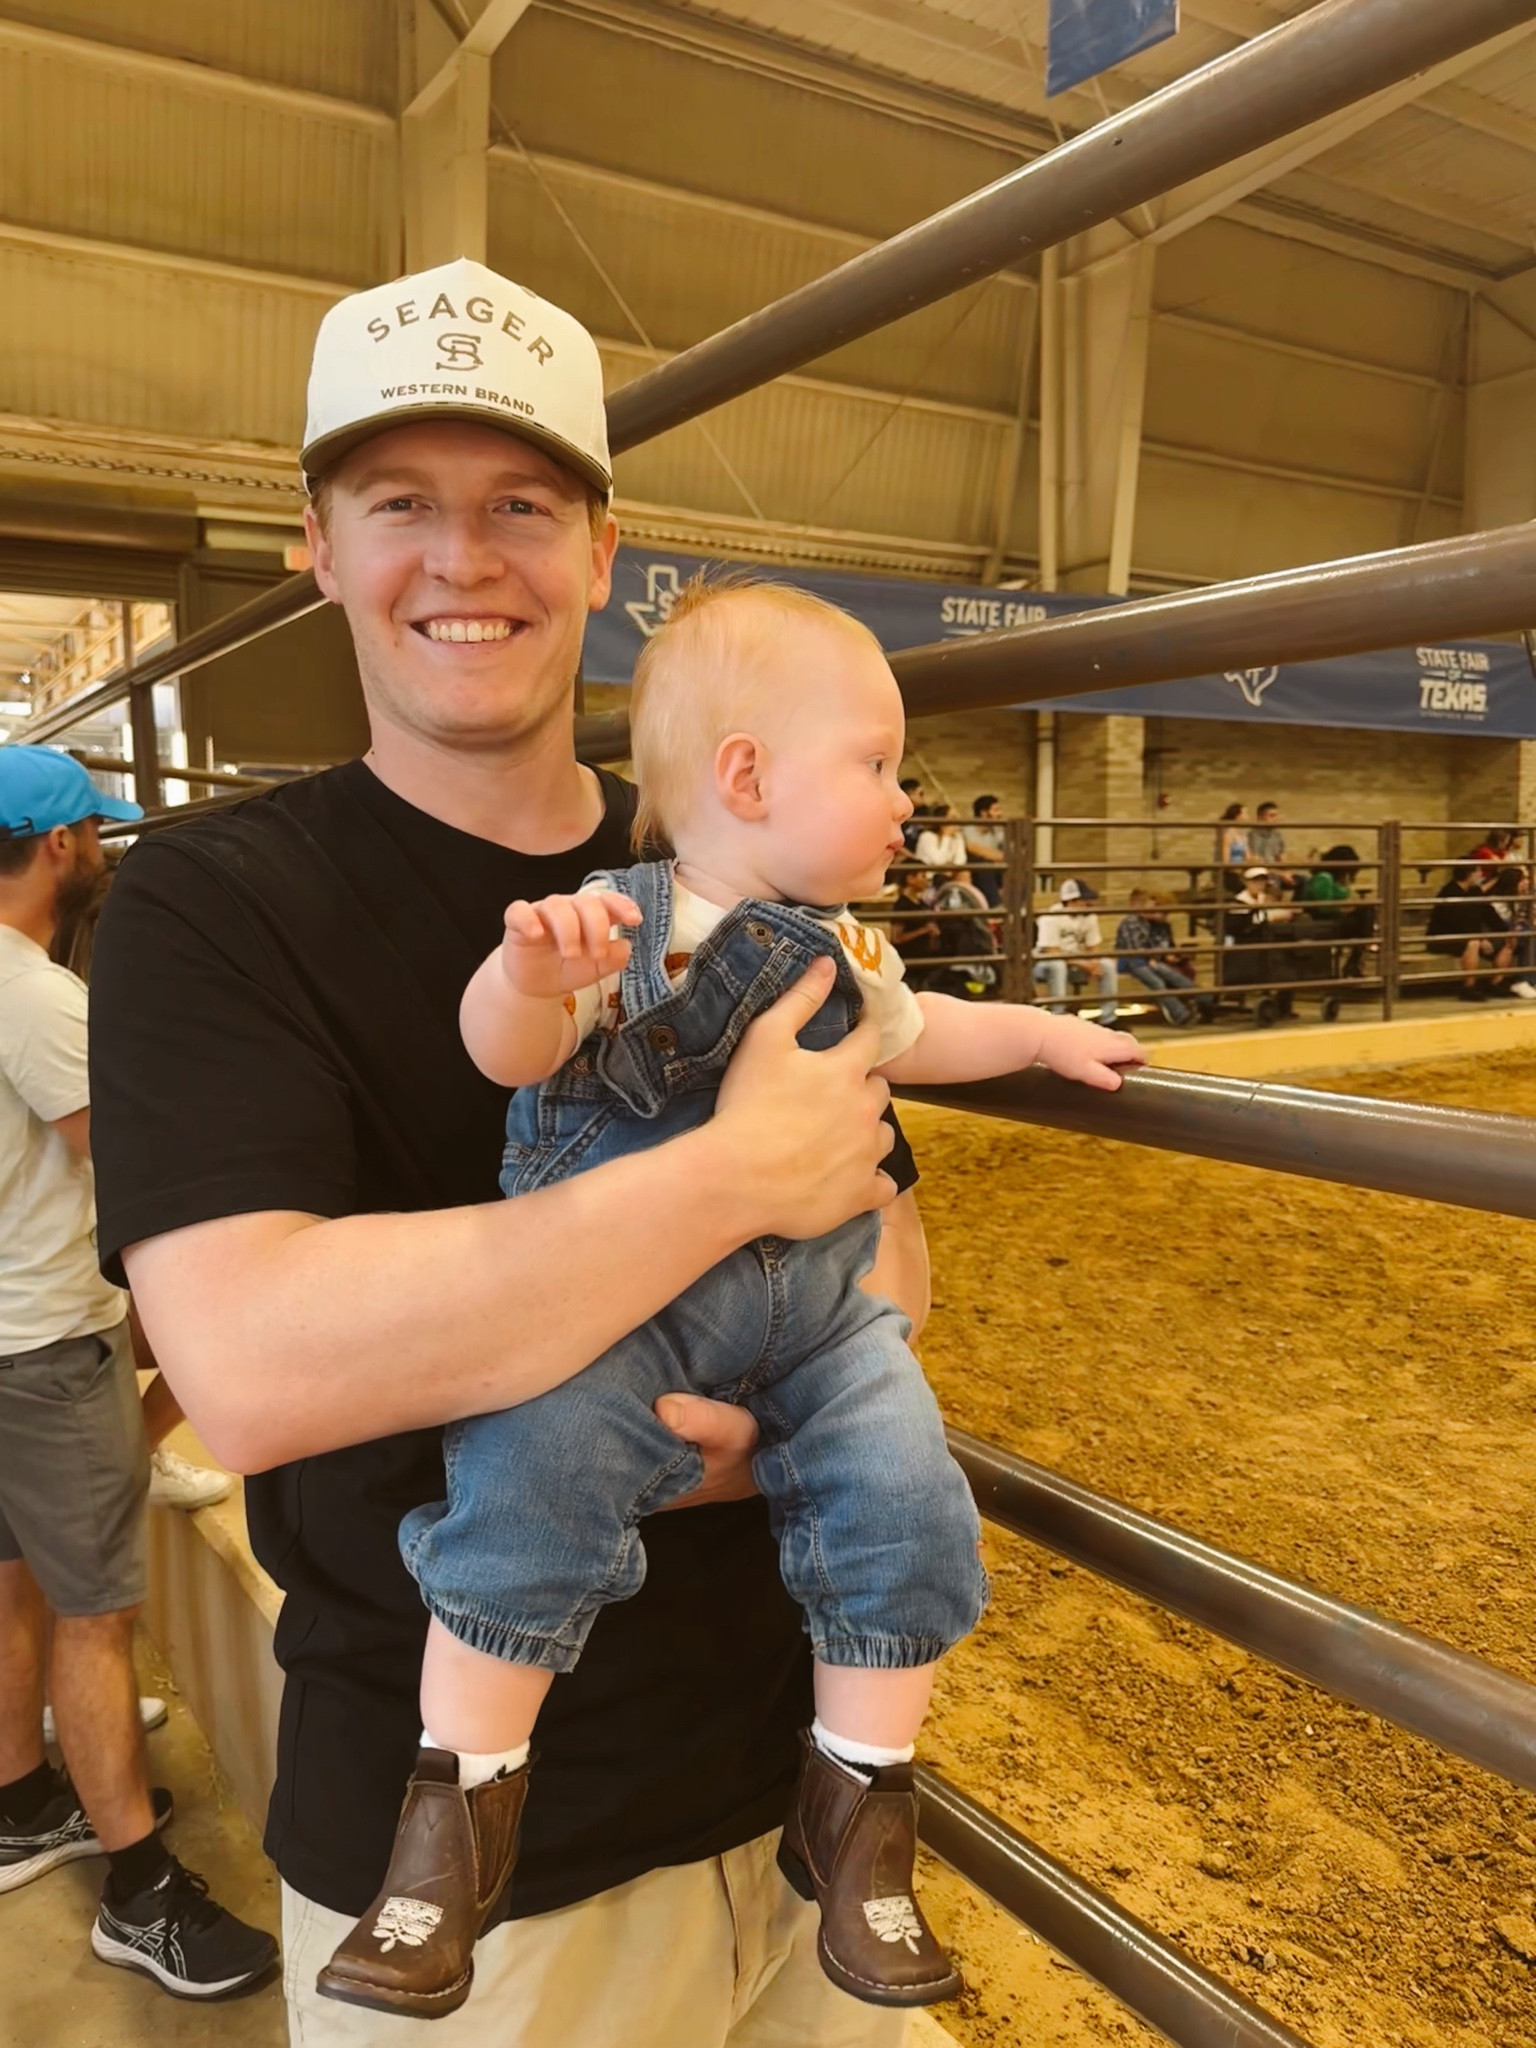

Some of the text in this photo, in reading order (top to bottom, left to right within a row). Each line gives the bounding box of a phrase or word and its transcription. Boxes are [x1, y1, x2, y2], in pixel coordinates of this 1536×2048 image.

[367, 292, 554, 366] SEAGER
[381, 383, 535, 416] WESTERN BRAND
[941, 596, 1001, 626] STATE
[1416, 647, 1489, 672] STATE FAIR
[1420, 679, 1488, 713] TEXAS
